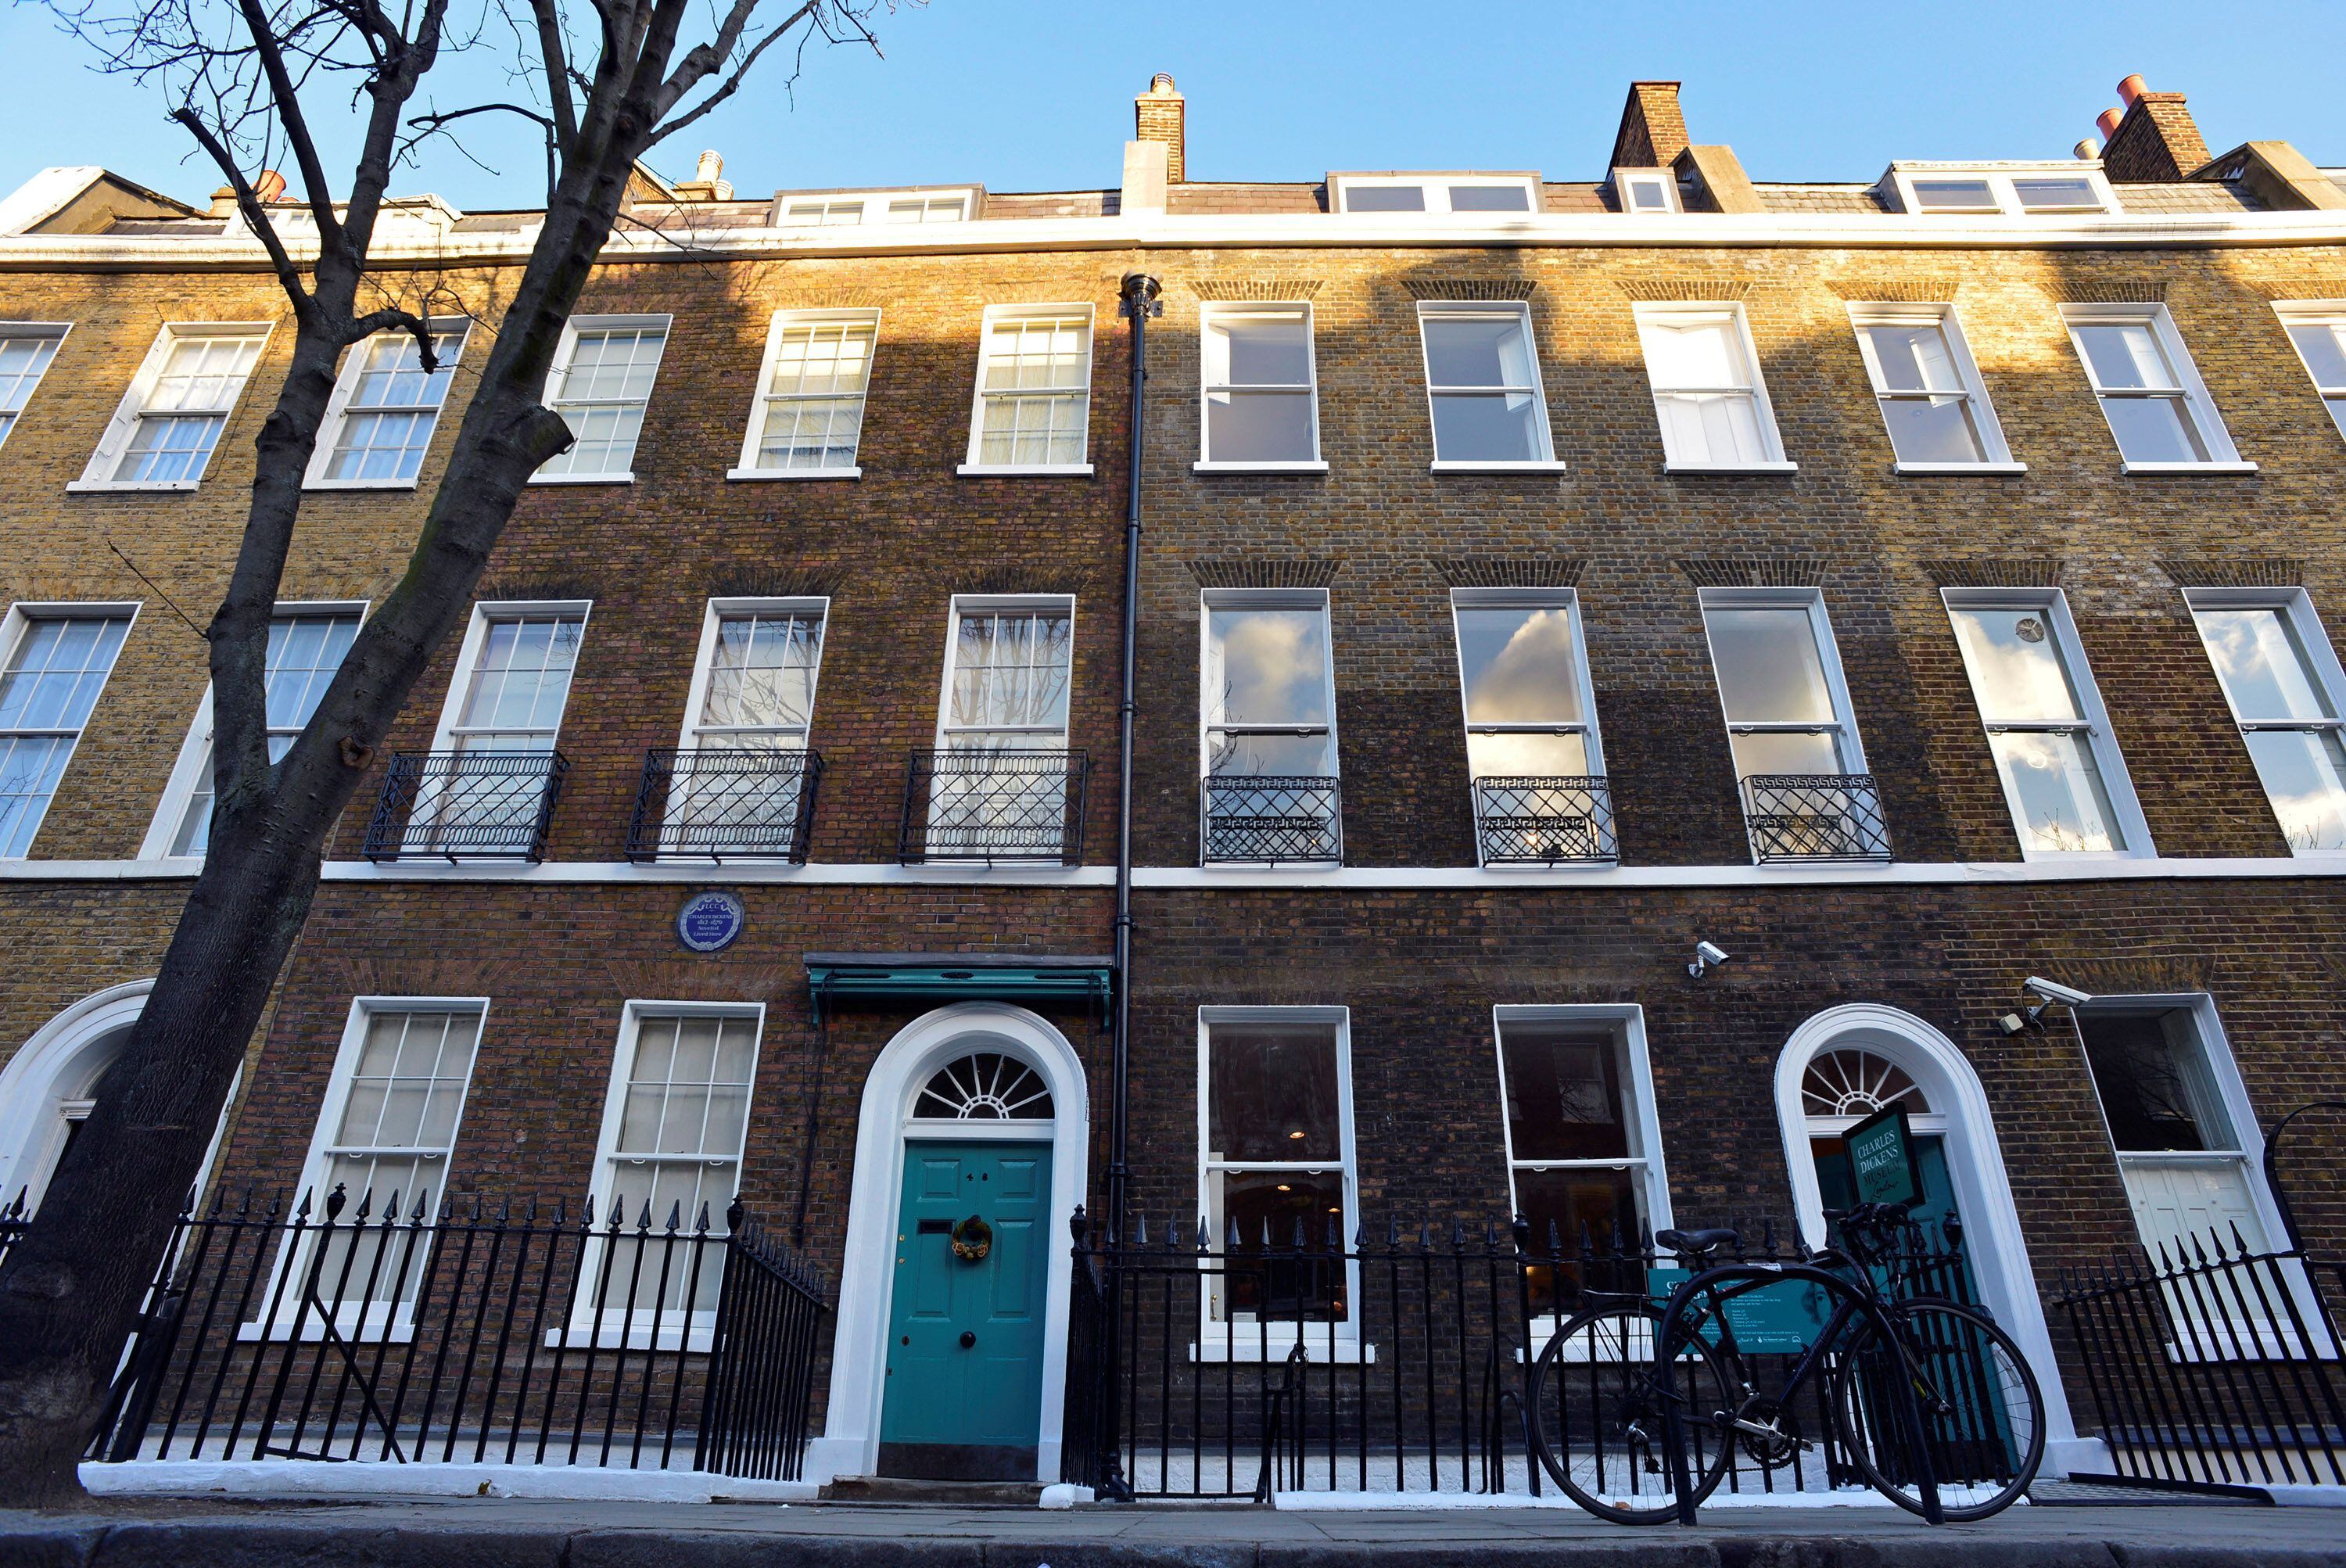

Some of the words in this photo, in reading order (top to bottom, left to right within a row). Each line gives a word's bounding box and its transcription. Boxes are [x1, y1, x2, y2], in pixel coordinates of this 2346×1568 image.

[1857, 1130, 1896, 1159] CHARLES
[1860, 1145, 1899, 1174] DICKENS
[1863, 1161, 1901, 1186] MUSEUM
